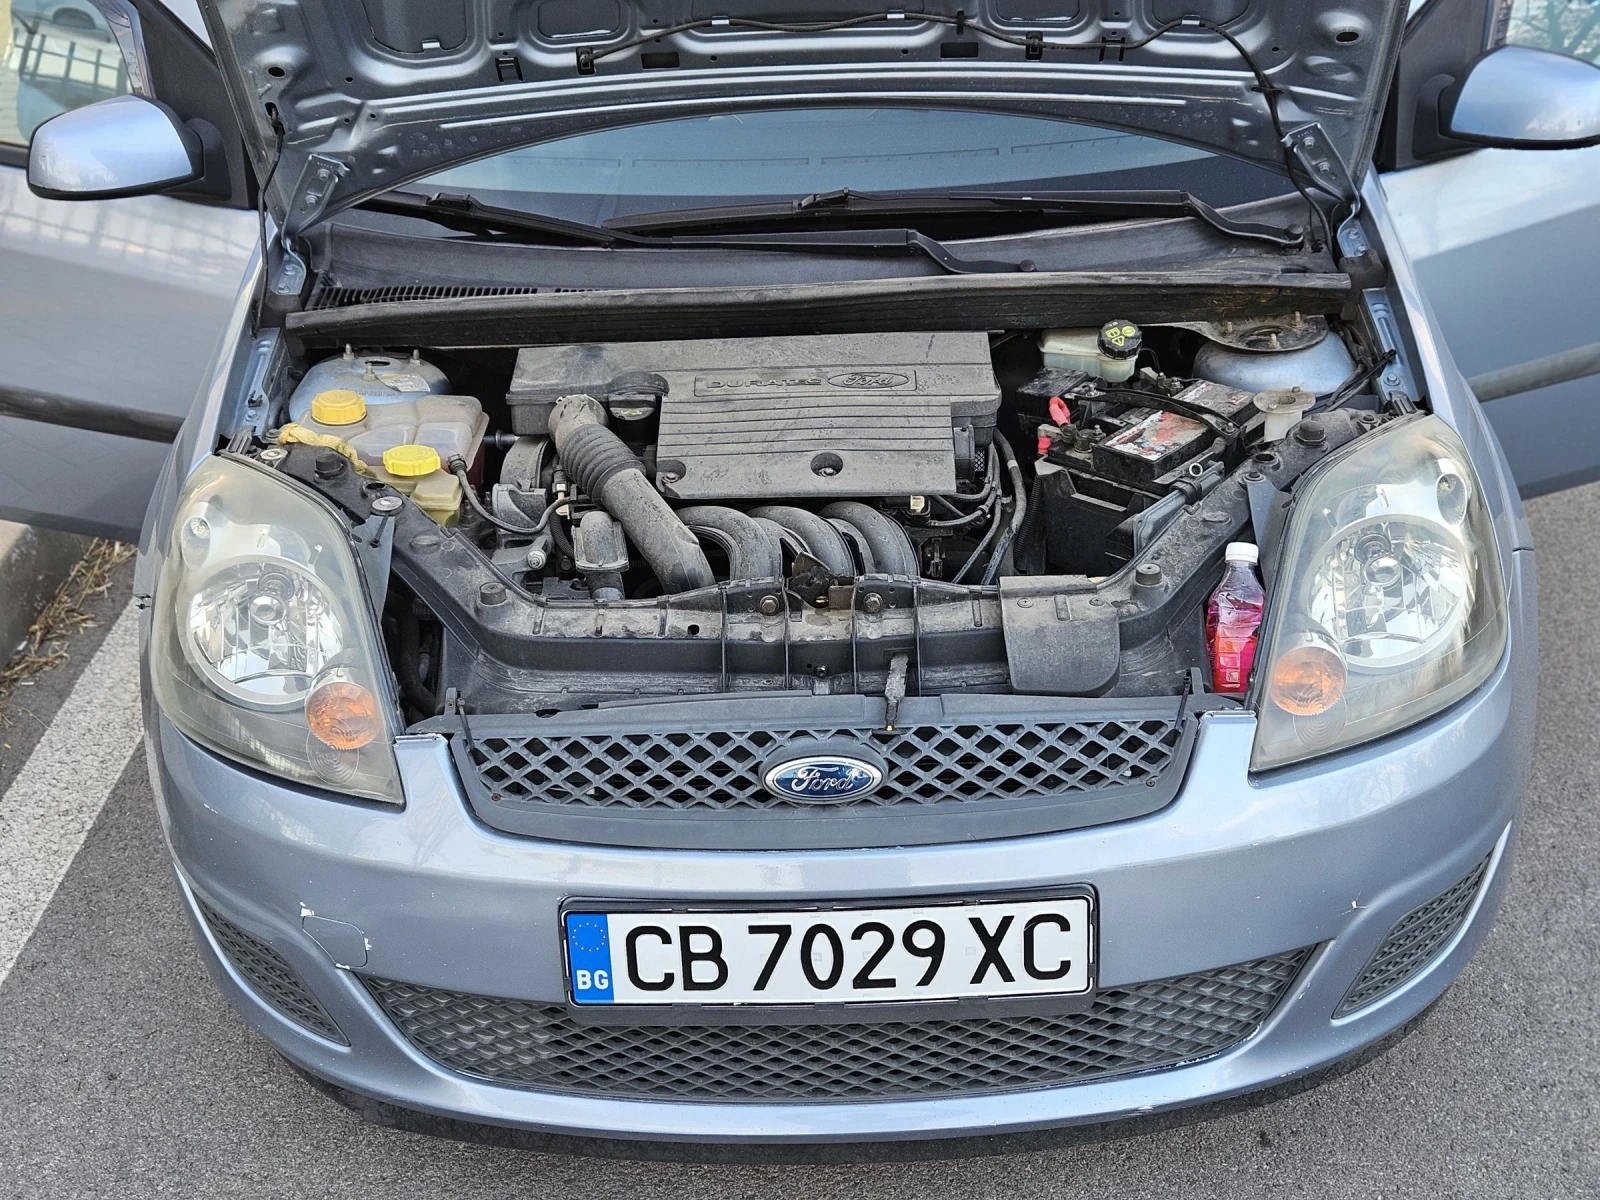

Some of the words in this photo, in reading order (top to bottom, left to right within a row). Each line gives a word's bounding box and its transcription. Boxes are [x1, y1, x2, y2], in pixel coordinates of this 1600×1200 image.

[843, 373, 895, 386] Ford
[791, 766, 861, 791] Ford
[625, 925, 729, 991] CB
[748, 919, 946, 991] 7029
[968, 913, 1072, 985] XC
[576, 969, 609, 990] BG
